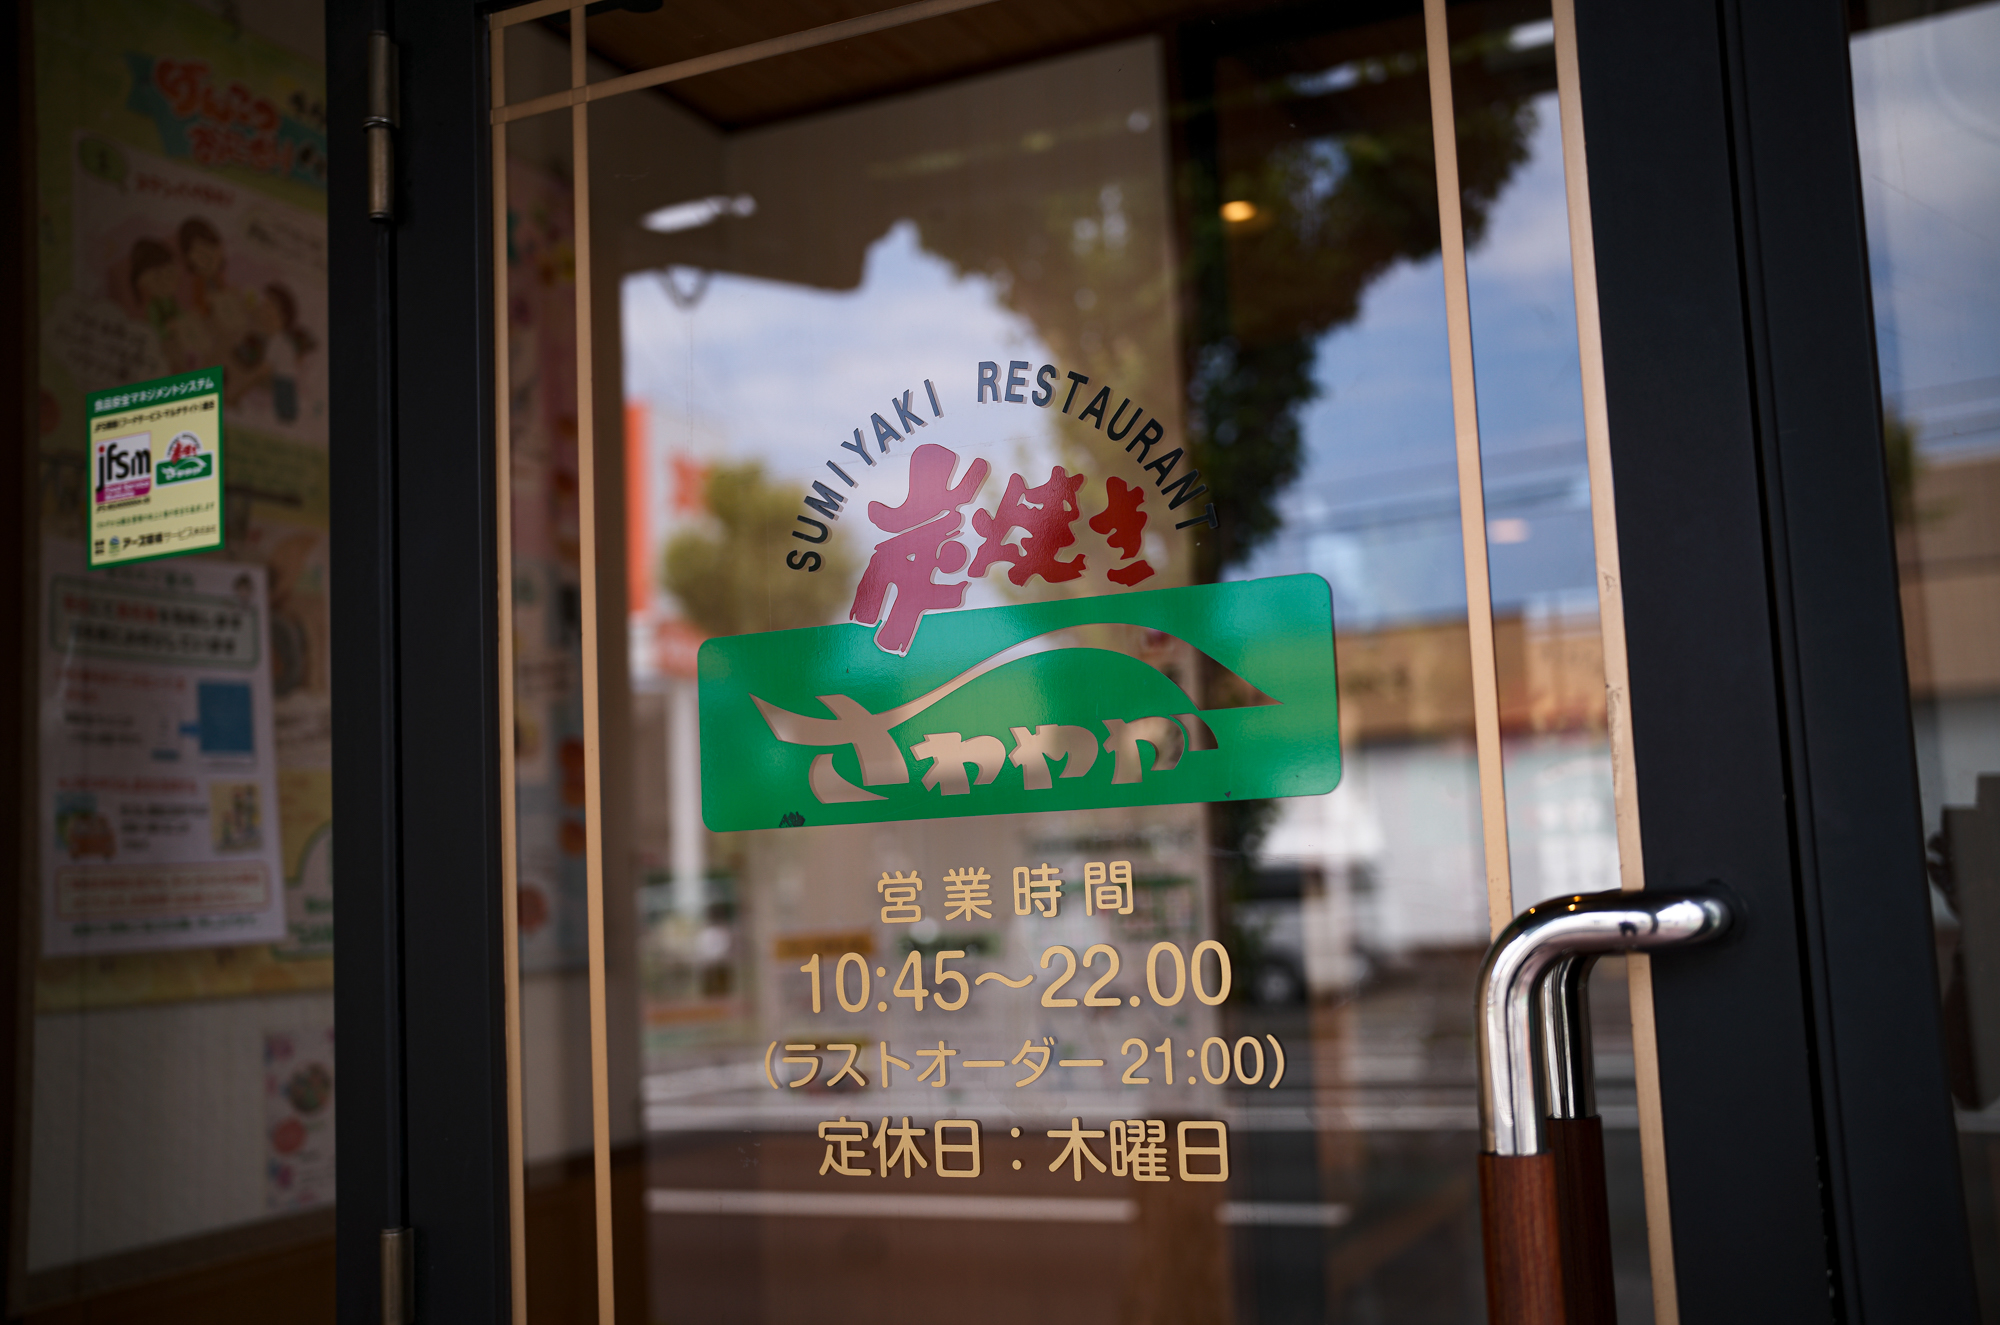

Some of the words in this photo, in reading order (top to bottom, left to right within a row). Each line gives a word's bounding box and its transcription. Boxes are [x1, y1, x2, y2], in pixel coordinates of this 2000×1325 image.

[95, 442, 151, 493] jfsm
[786, 379, 944, 573] SUMIYAKI
[977, 360, 1219, 531] RESTAURANT
[849, 443, 1155, 657] 炭焼き
[749, 623, 1285, 805] さわやか
[877, 860, 1134, 924] 営業時間
[1120, 1034, 1285, 1089] 21:00)
